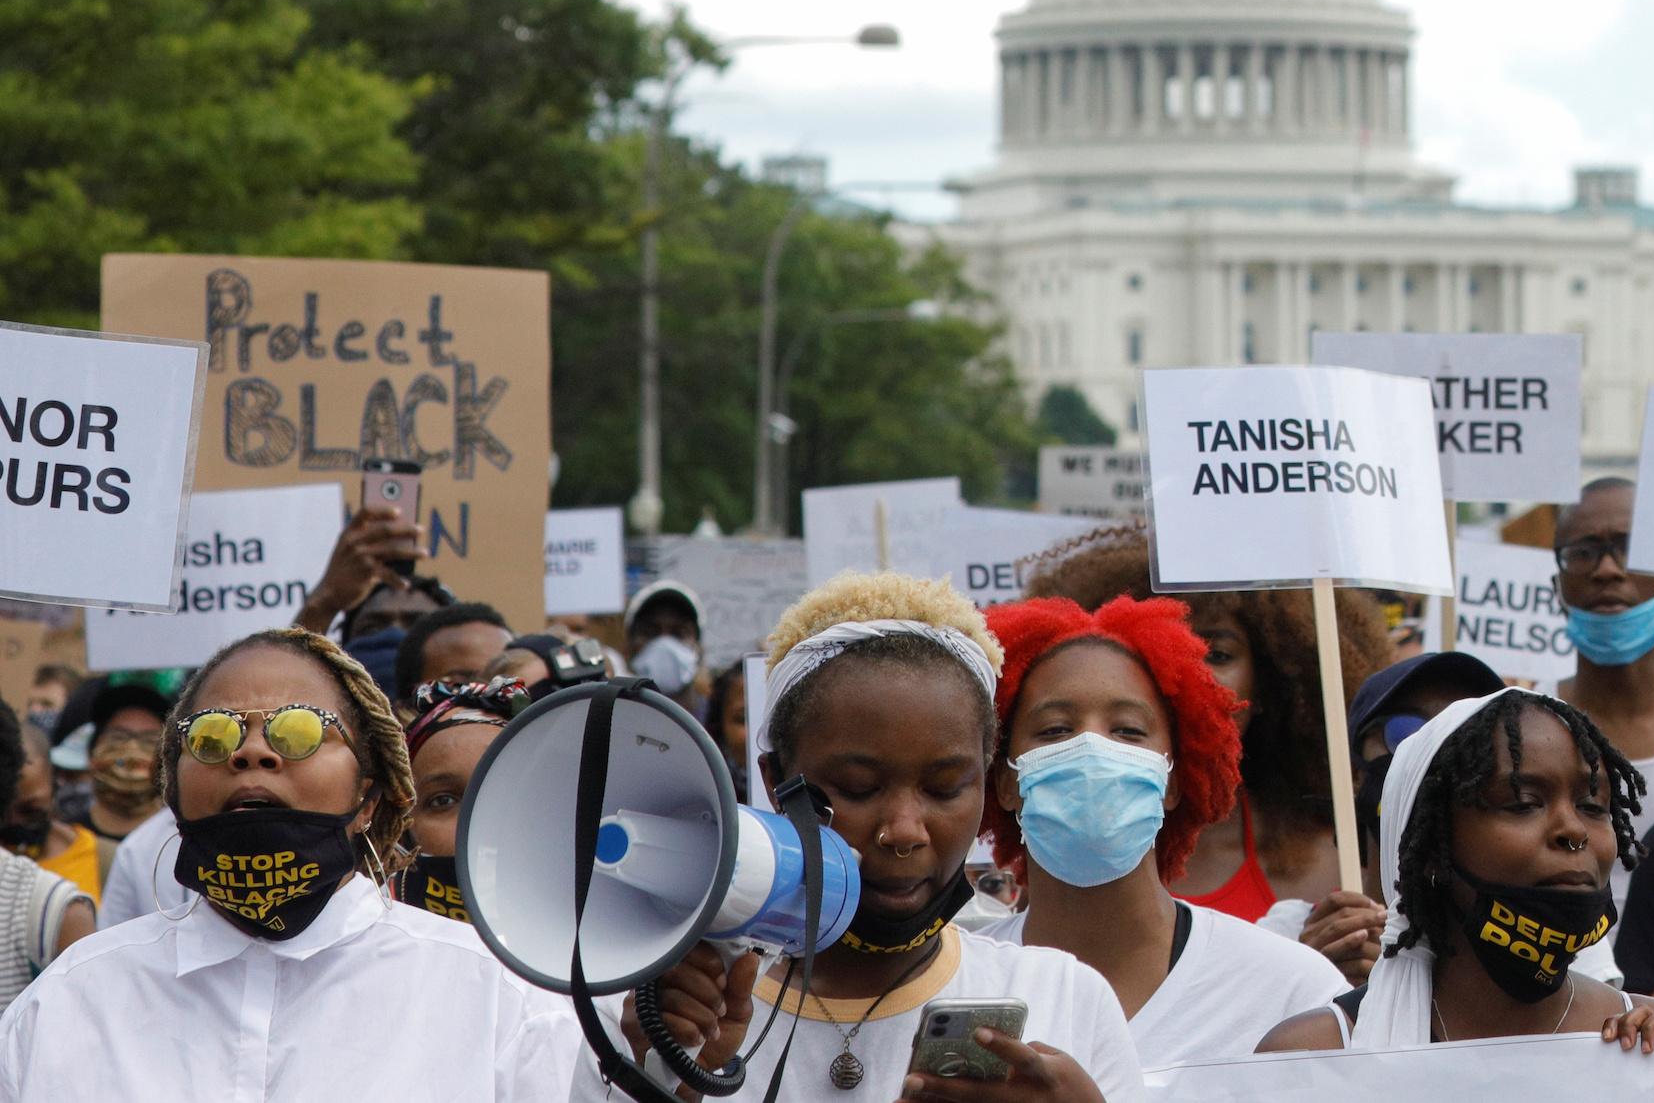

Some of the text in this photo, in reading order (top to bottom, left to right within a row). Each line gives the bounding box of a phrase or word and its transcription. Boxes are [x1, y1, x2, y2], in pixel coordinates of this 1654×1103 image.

[205, 268, 456, 373] Protect
[224, 362, 513, 480] BLACK
[1188, 418, 1355, 452] TANISHA
[1438, 421, 1523, 454] KER
[0, 457, 131, 515] URS
[1192, 461, 1399, 499] ANDERSON
[197, 862, 320, 888] KILLING
[216, 850, 296, 871] STOP
[206, 880, 312, 905] BLACK
[1490, 899, 1609, 953] DEFUND
